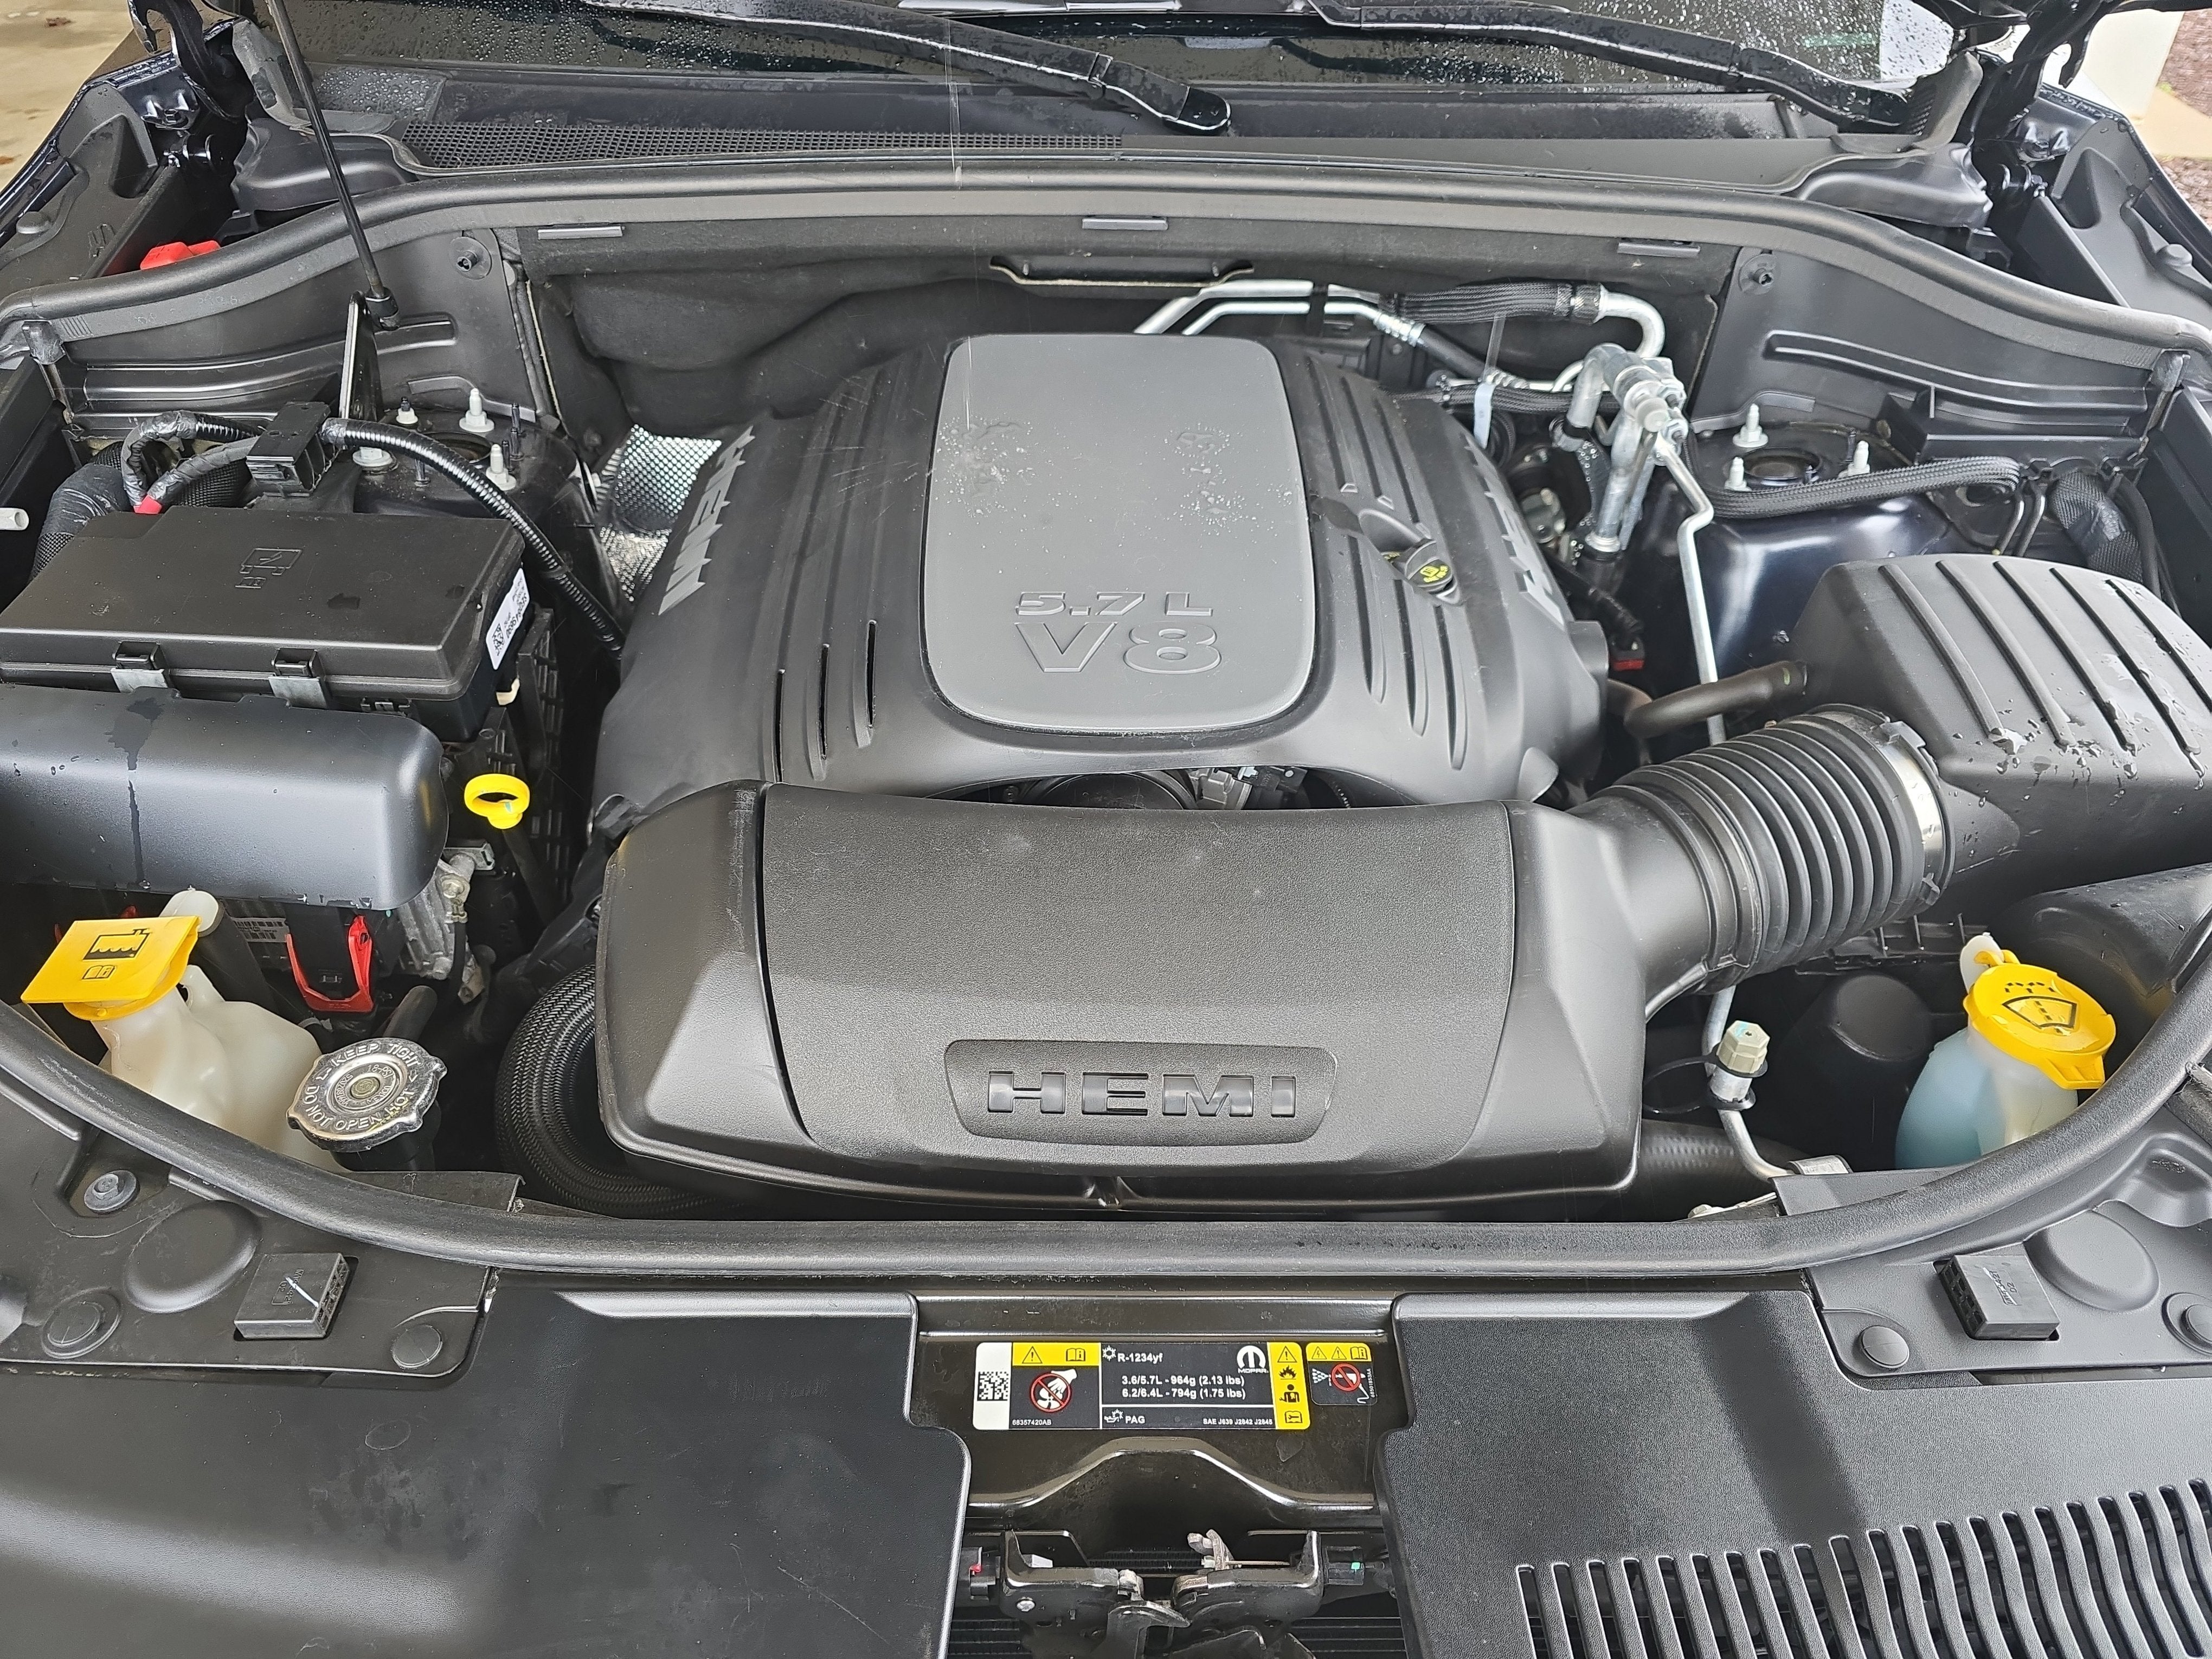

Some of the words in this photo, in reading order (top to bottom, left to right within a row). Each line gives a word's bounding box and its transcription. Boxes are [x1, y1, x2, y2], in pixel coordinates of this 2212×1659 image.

[1014, 621, 1222, 674] V8
[330, 1043, 380, 1066] KEEP
[387, 1043, 422, 1068] TIGHT
[303, 1085, 320, 1105] DO
[365, 1085, 391, 1105] MEXICO
[384, 1088, 415, 1116] HOT
[987, 1071, 1297, 1118] HEMI
[305, 1104, 333, 1127] NOT
[335, 1114, 383, 1131] OPEN
[1117, 1352, 1163, 1364] R-1234yf
[1122, 1375, 1163, 1385] 3.6/5.7L
[1170, 1375, 1196, 1386] 964g
[1199, 1375, 1223, 1387] (2.13
[1225, 1375, 1245, 1387] lbs)
[1122, 1388, 1163, 1398] 6.2/6.4L
[1171, 1388, 1197, 1399] 794g
[1200, 1388, 1224, 1400] (1.75
[1226, 1388, 1246, 1400] lbs)
[1125, 1416, 1146, 1424] PAG
